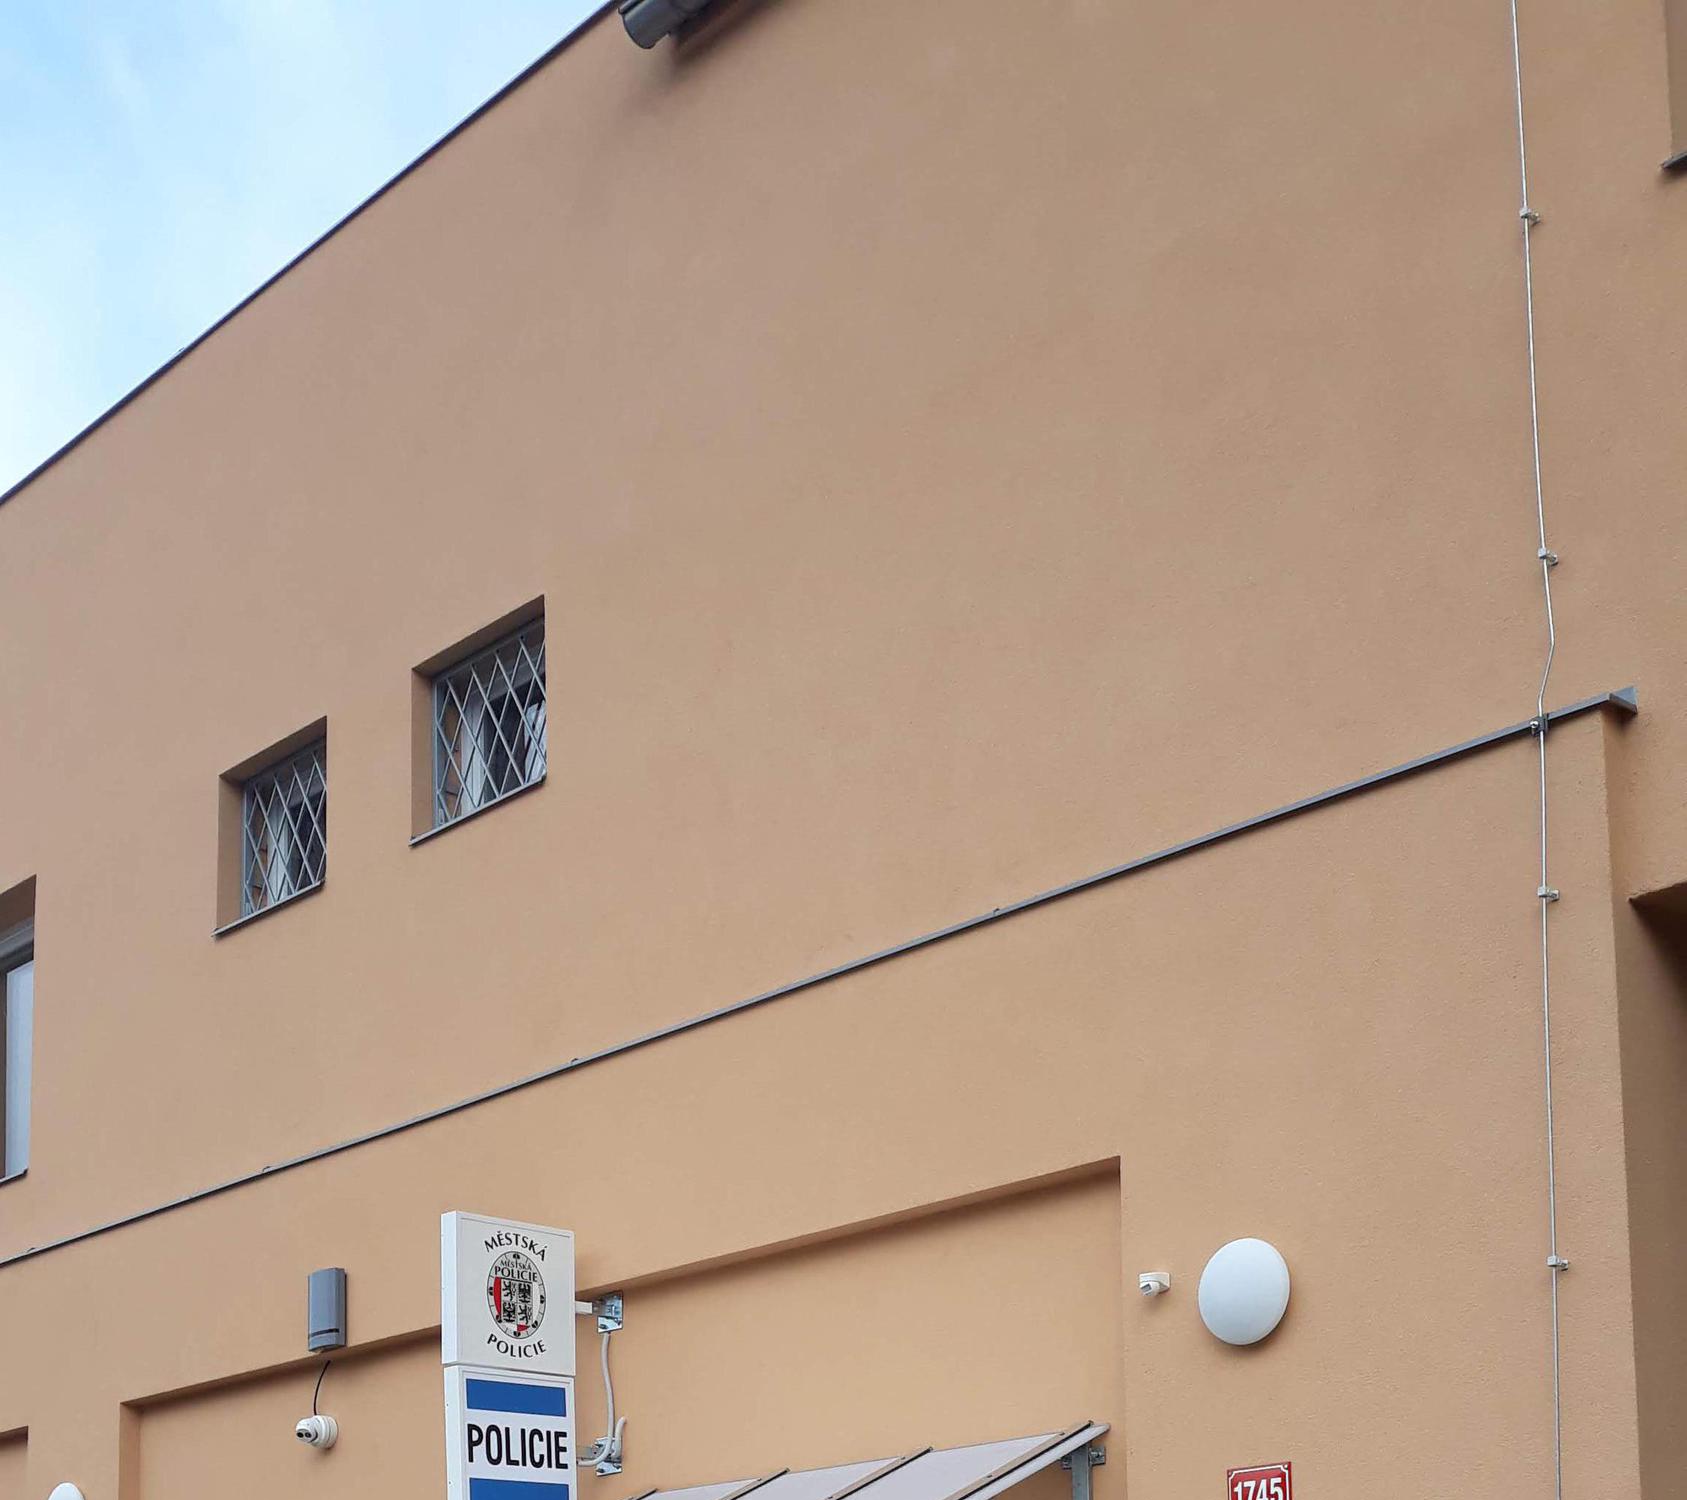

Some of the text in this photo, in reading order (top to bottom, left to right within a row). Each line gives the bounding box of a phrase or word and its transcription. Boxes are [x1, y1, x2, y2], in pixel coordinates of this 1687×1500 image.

[484, 1231, 547, 1261] MĚSTSKÁ
[494, 1266, 538, 1282] POLICIE
[487, 1333, 547, 1358] POLICIE
[467, 1423, 568, 1469] POLICIE
